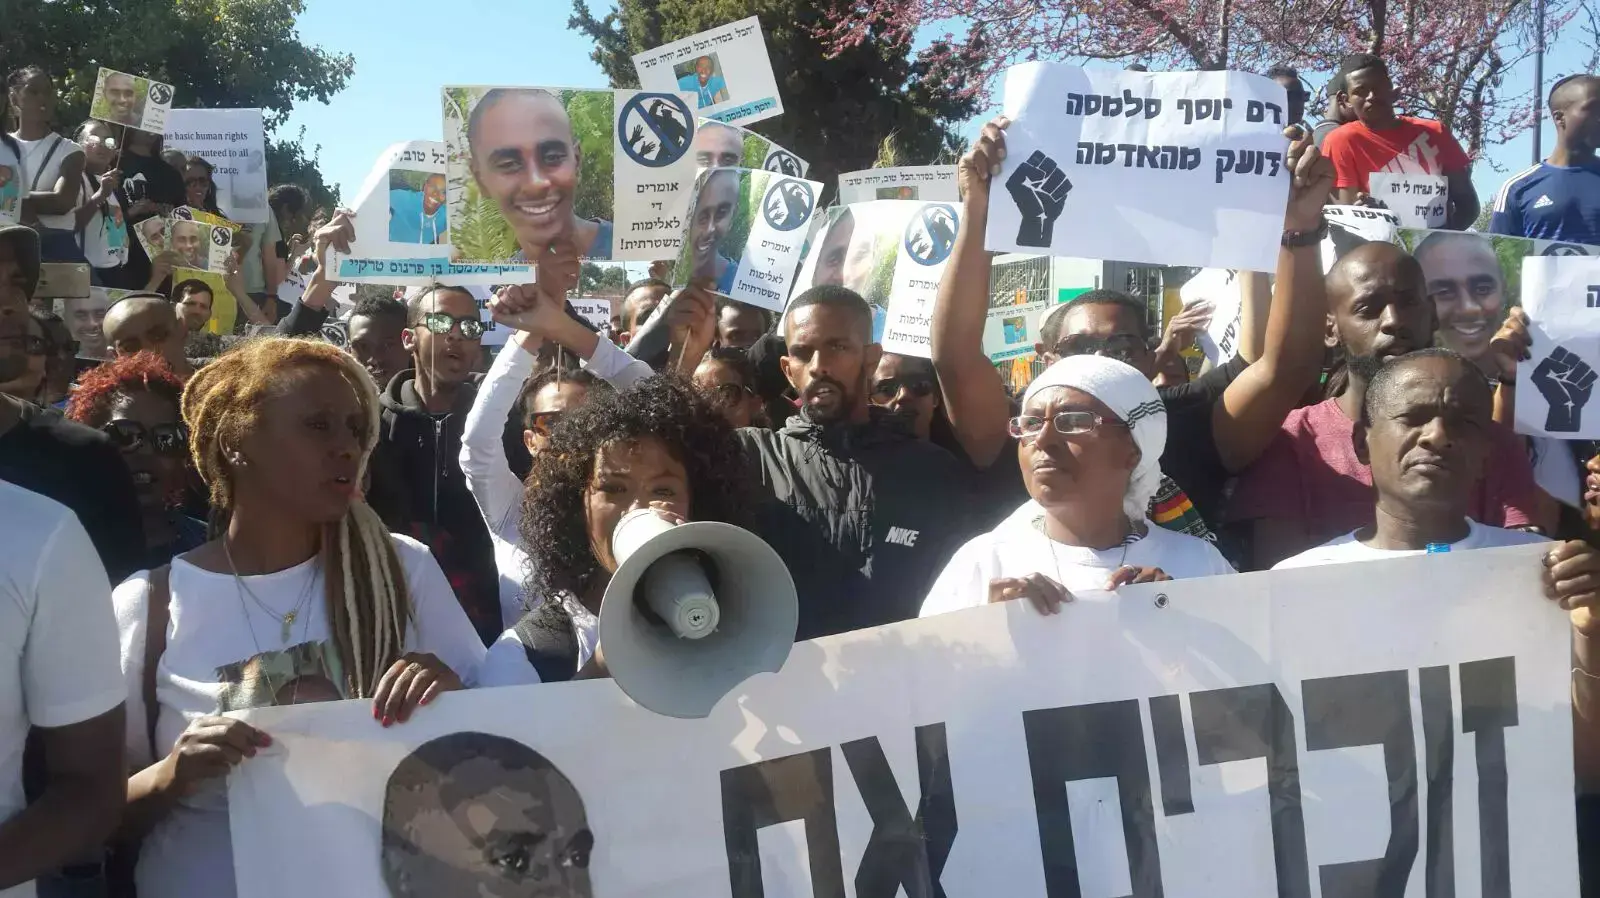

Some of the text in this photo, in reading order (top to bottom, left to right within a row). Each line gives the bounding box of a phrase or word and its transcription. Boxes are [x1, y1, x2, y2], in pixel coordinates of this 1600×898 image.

[754, 101, 771, 114] יוסף
[1066, 89, 1282, 125] דם יוסף סלמסה
[175, 132, 194, 140] basic
[196, 132, 222, 140] human
[224, 132, 248, 142] rights
[228, 149, 237, 157] to
[239, 149, 249, 157] all
[1076, 141, 1281, 183] זועק מהאדמה
[220, 167, 239, 175] race,
[636, 182, 680, 193] אומרים
[1435, 182, 1447, 196] אל
[651, 201, 663, 211] די
[1433, 203, 1444, 216] לא
[631, 216, 681, 231] לאלימות
[620, 238, 681, 250] משטרתית!
[761, 240, 791, 253] אומרים
[350, 258, 384, 274] טרקיי
[389, 261, 425, 275] פרנוס
[767, 257, 776, 266] די
[431, 263, 443, 276] בן
[749, 268, 784, 284] לאלימות
[737, 279, 781, 300] משטרתית!
[908, 279, 940, 290] אומרים
[597, 304, 609, 314] אל
[916, 298, 926, 308] די
[885, 526, 920, 548] NIKE
[1022, 655, 1518, 898] זוכרים
